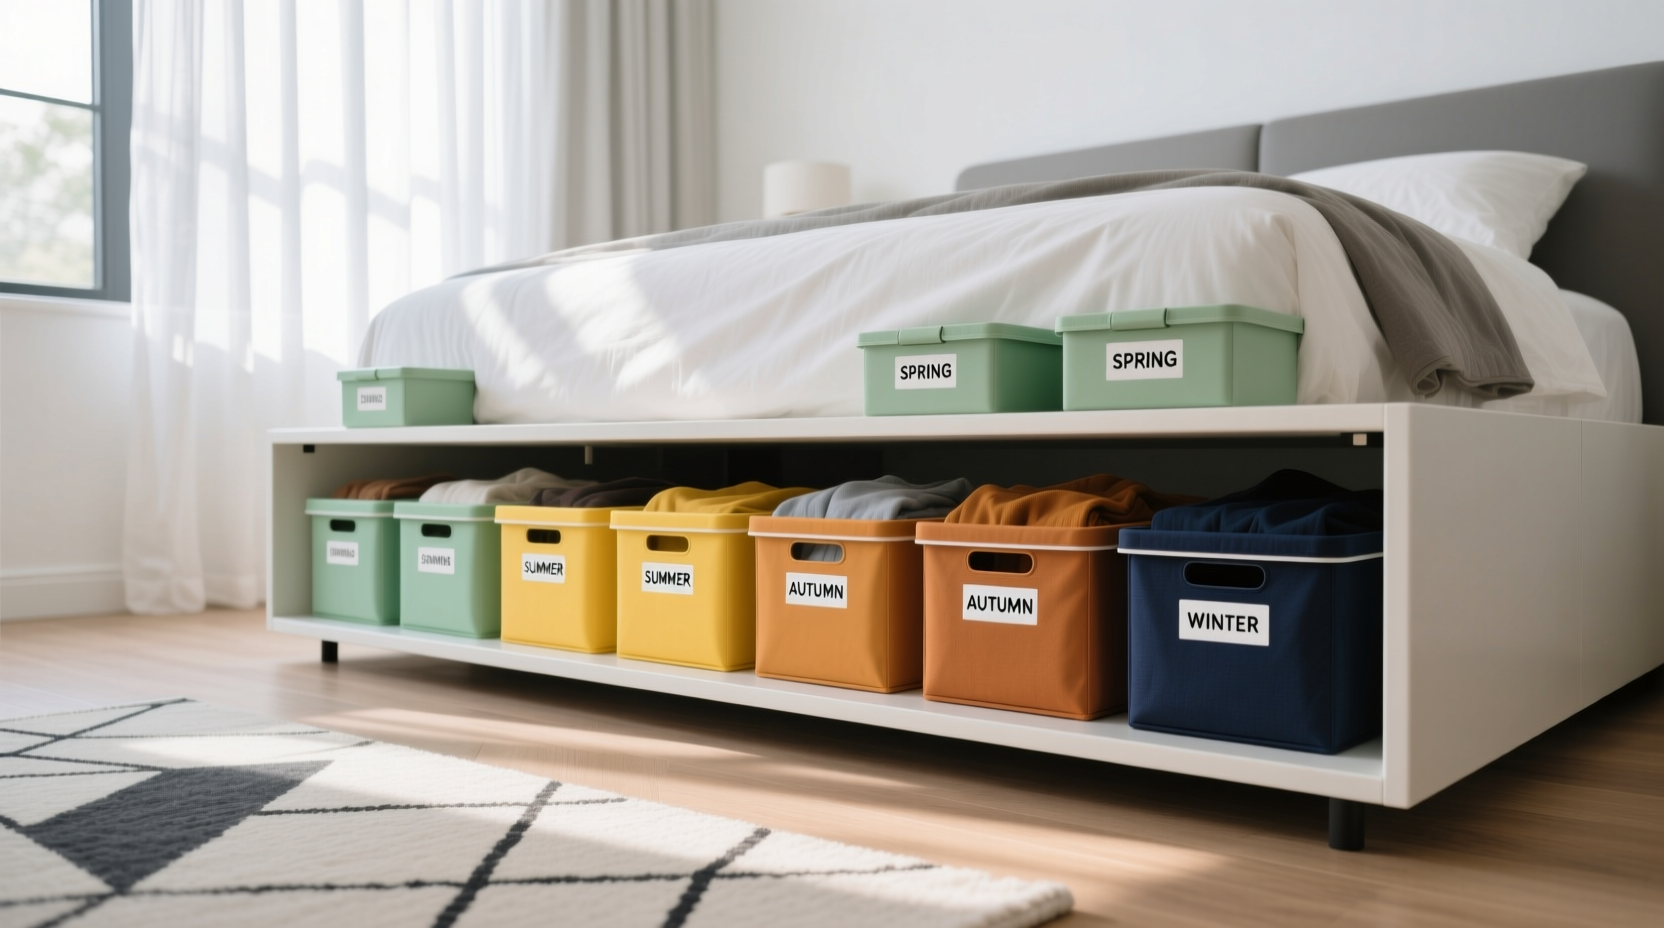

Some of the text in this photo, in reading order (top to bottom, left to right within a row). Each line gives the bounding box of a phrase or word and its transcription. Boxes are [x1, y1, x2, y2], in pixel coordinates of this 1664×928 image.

[1112, 349, 1178, 370] SPRING
[900, 362, 952, 380] SPRING
[524, 560, 563, 575] SUMMER
[645, 570, 691, 587] SUMMER
[788, 581, 844, 599] AUTUMN
[966, 595, 1034, 615] AUTUMN
[1187, 611, 1260, 633] WINTER
